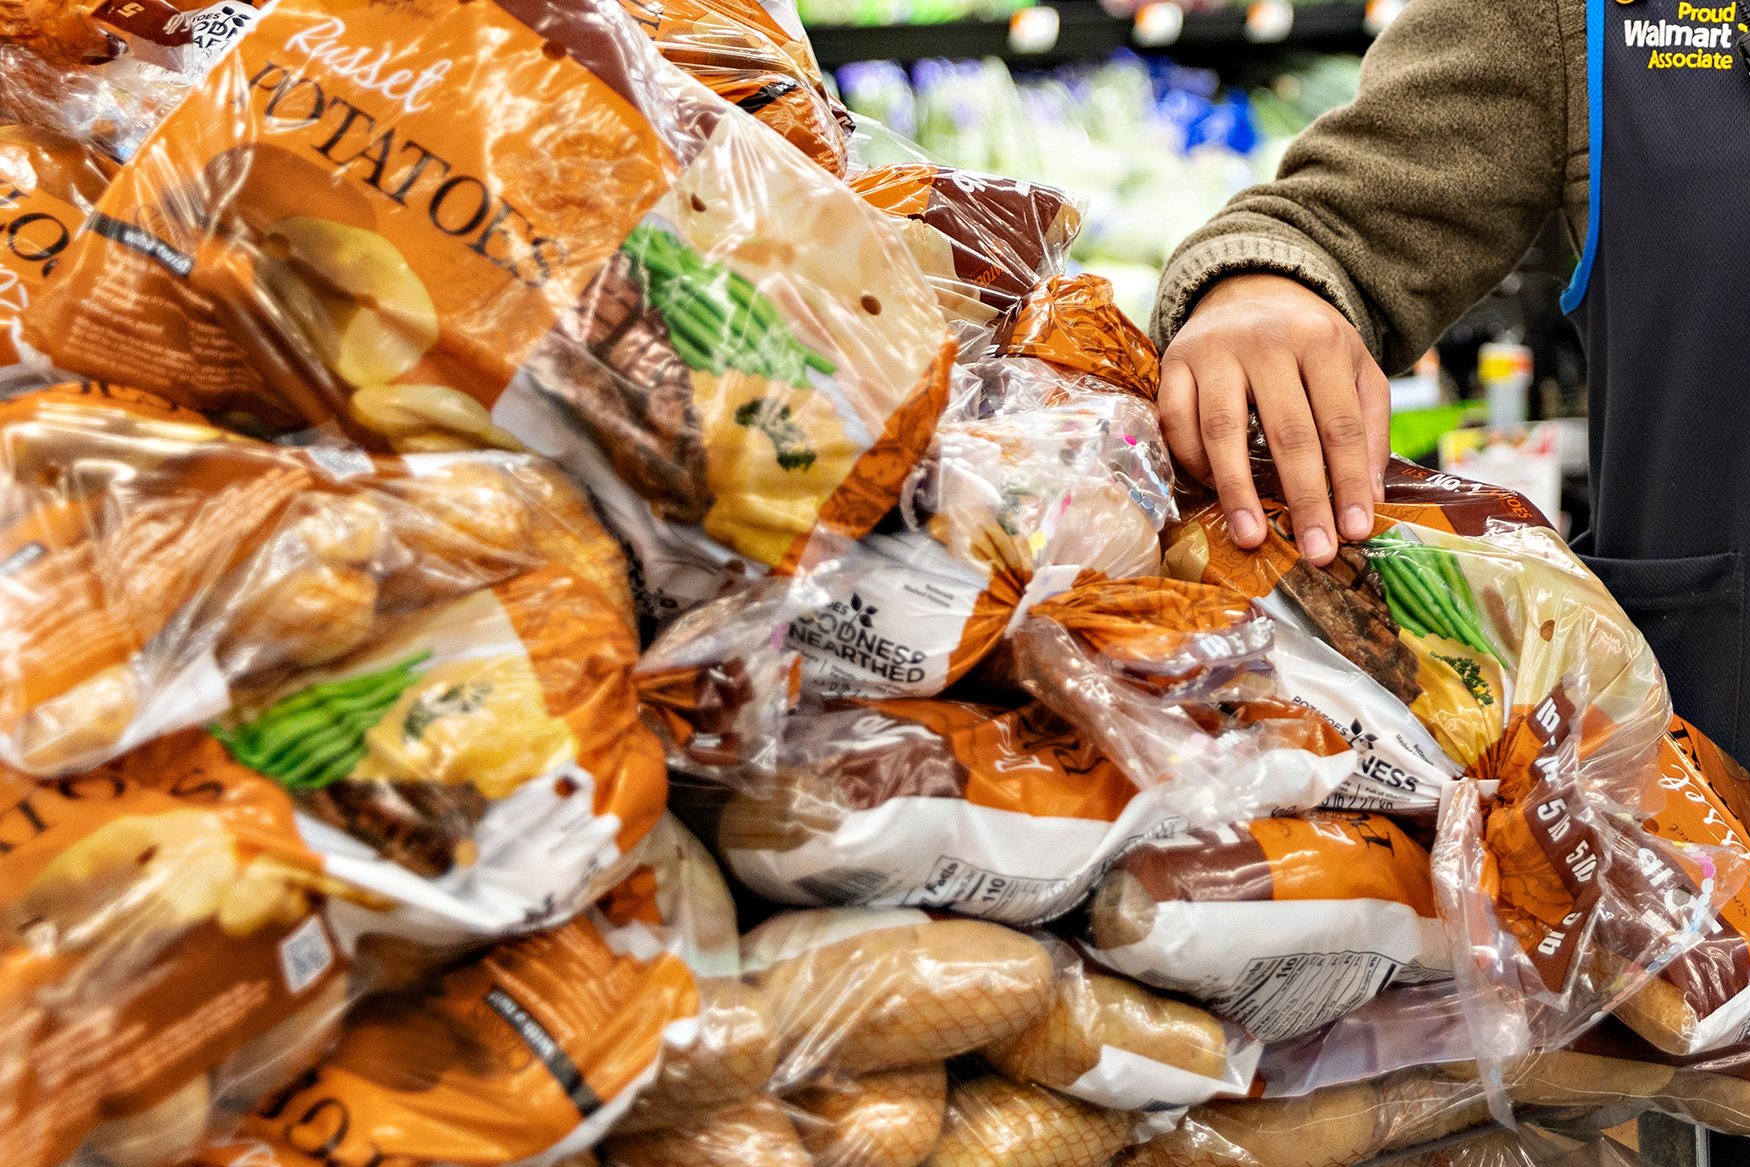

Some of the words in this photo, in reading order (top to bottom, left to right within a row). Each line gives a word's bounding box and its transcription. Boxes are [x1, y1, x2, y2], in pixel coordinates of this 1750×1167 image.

[1678, 1, 1737, 23] Proud
[1624, 19, 1733, 49] Walmart
[284, 16, 454, 113] Russet
[1648, 49, 1734, 70] Associate
[247, 61, 571, 289] POTATOES
[156, 245, 192, 273] twist
[1426, 473, 1461, 493] No.
